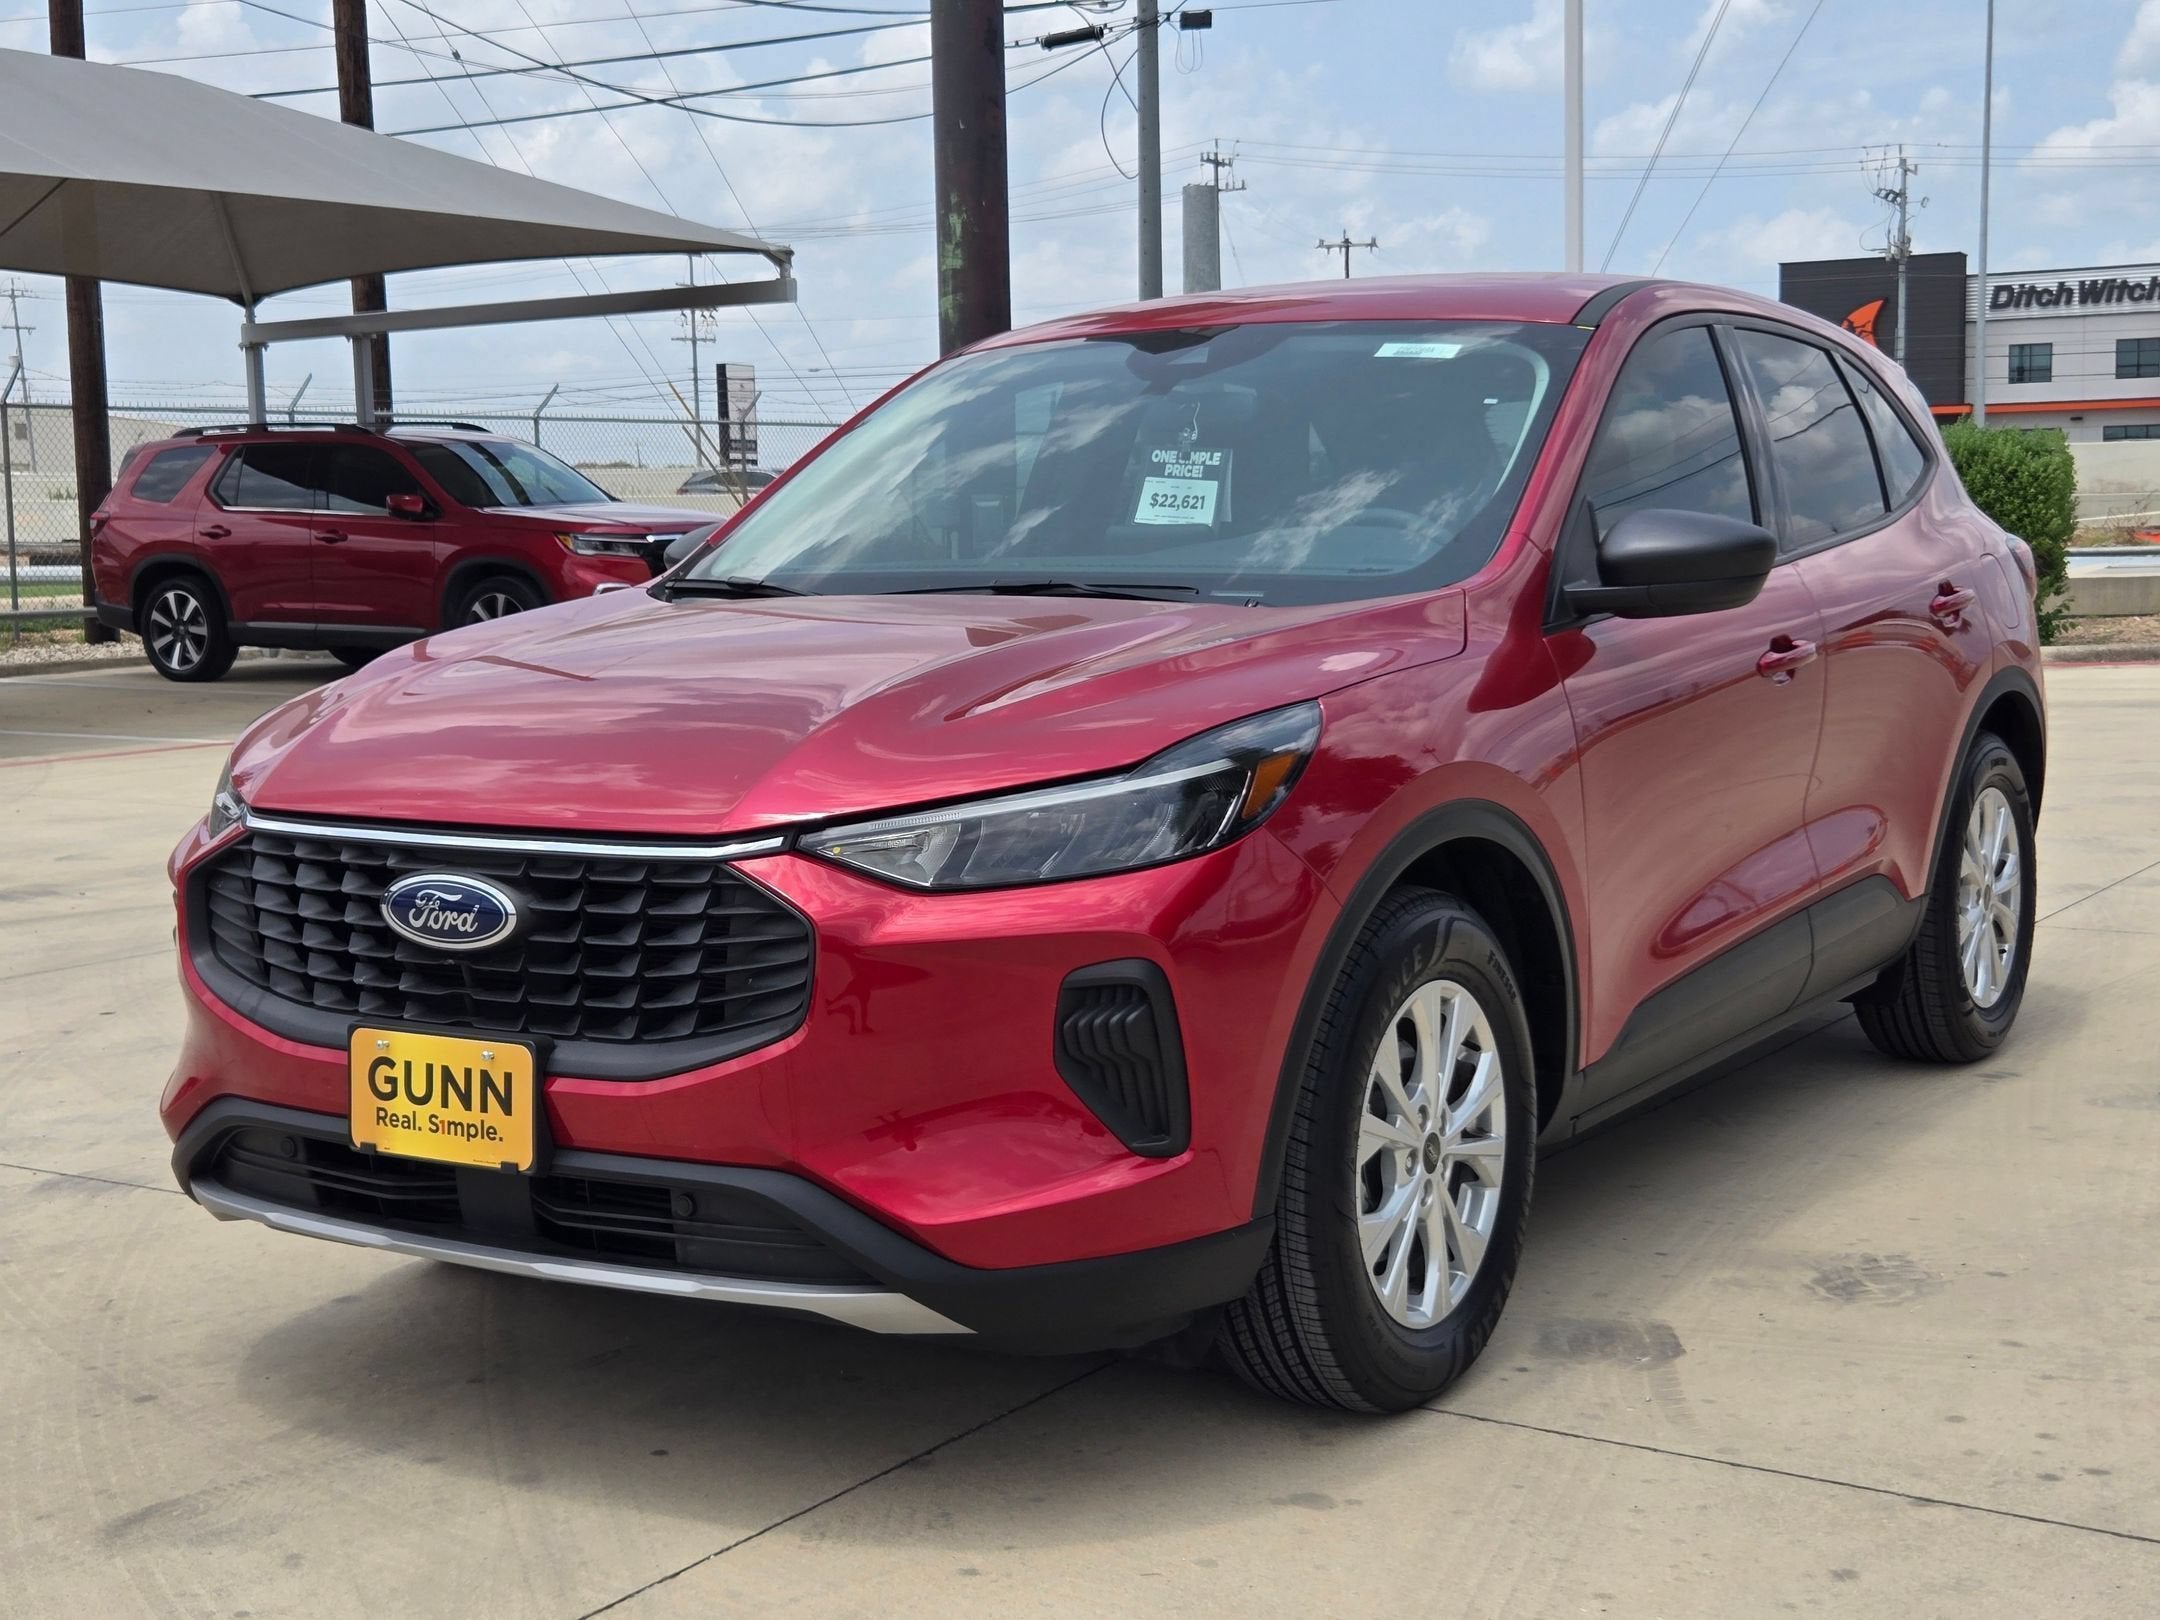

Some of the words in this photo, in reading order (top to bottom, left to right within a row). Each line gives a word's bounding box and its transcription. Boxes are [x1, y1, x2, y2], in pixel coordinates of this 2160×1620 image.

[1989, 282, 2074, 309] Ditch
[2078, 276, 2160, 305] Witch
[1151, 449, 1178, 463] ONE
[1164, 463, 1204, 478] PRICE!
[1149, 492, 1206, 511] $22,621
[408, 889, 481, 933] Ford
[368, 1055, 513, 1117] GUNN
[375, 1106, 422, 1132] Real.
